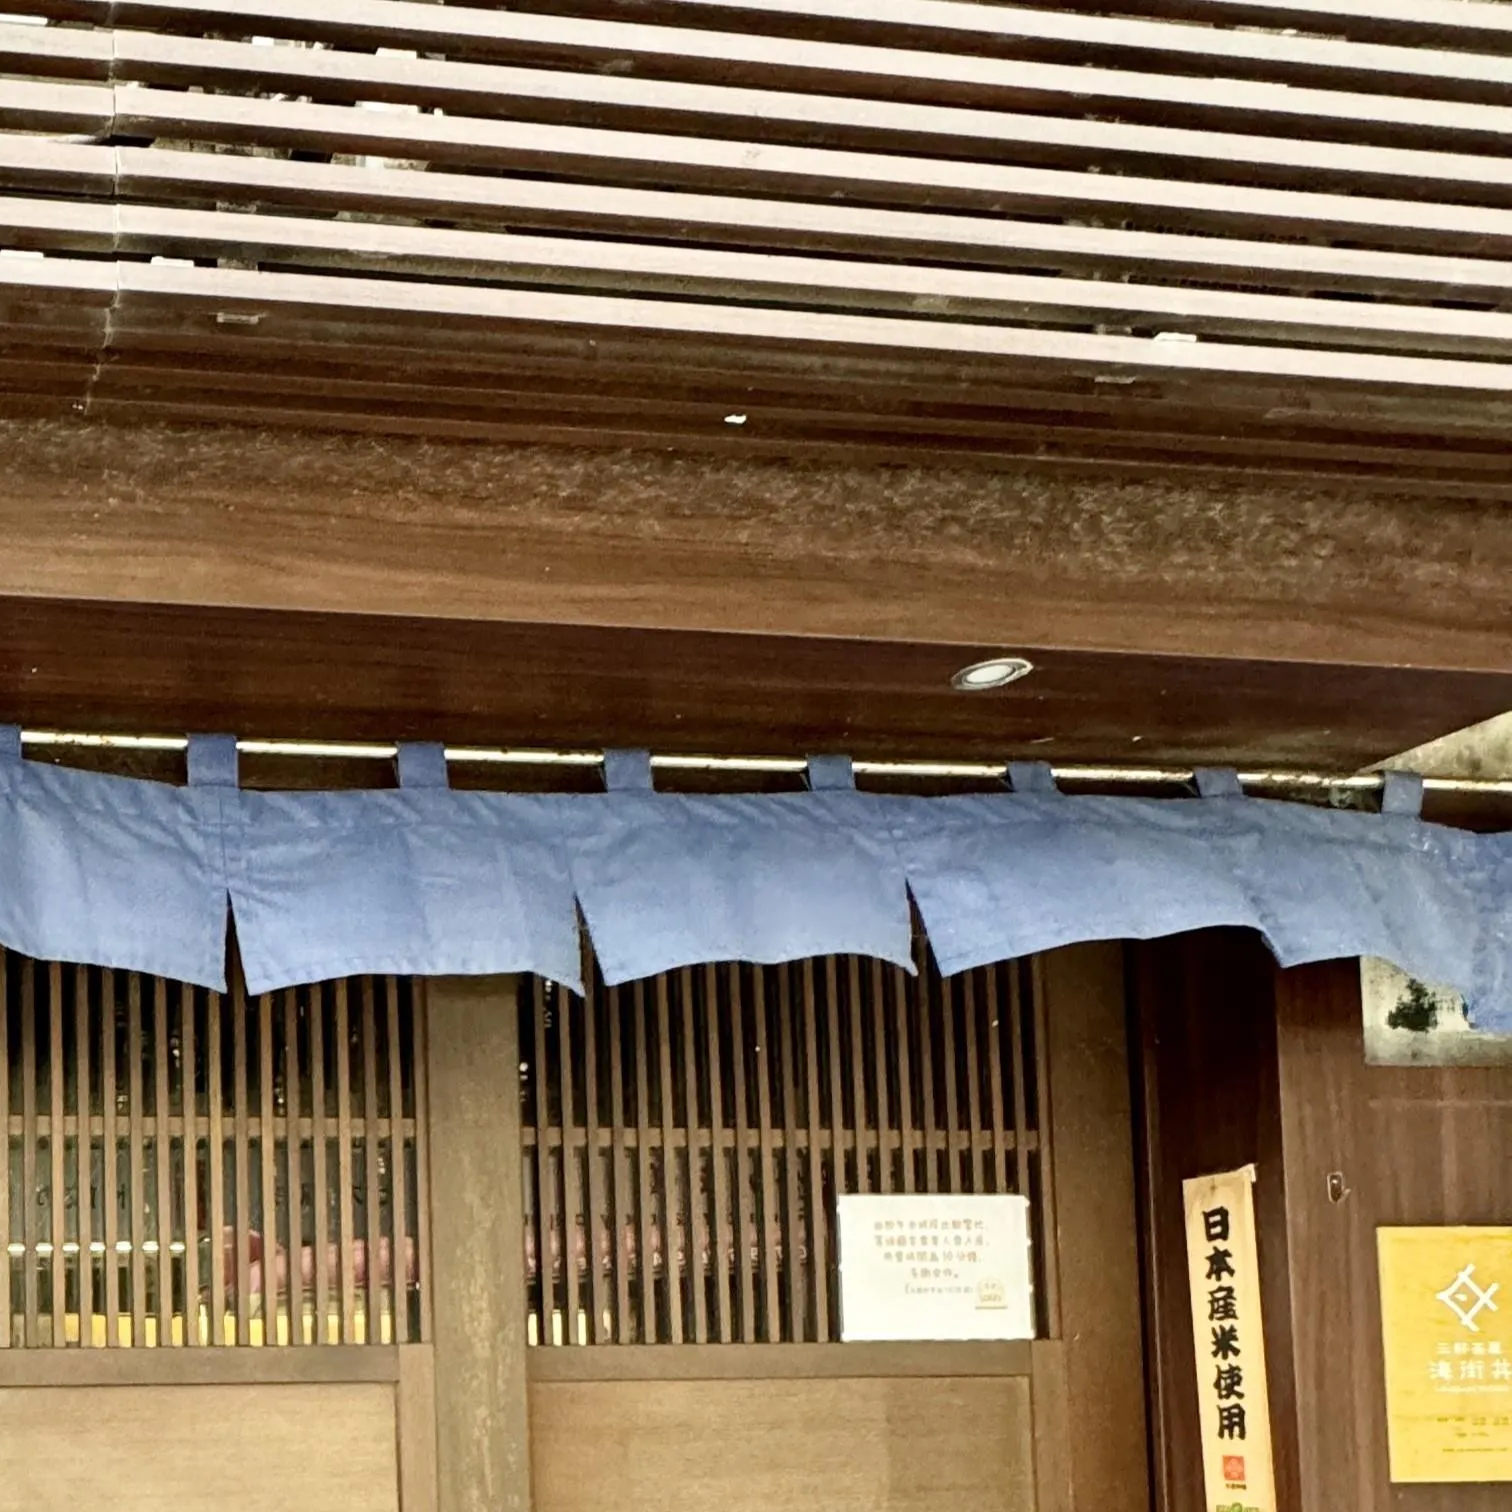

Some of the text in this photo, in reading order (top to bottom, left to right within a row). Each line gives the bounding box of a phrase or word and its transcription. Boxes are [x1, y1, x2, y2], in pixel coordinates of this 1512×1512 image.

[1201, 1205, 1247, 1441] 日本産米使用
